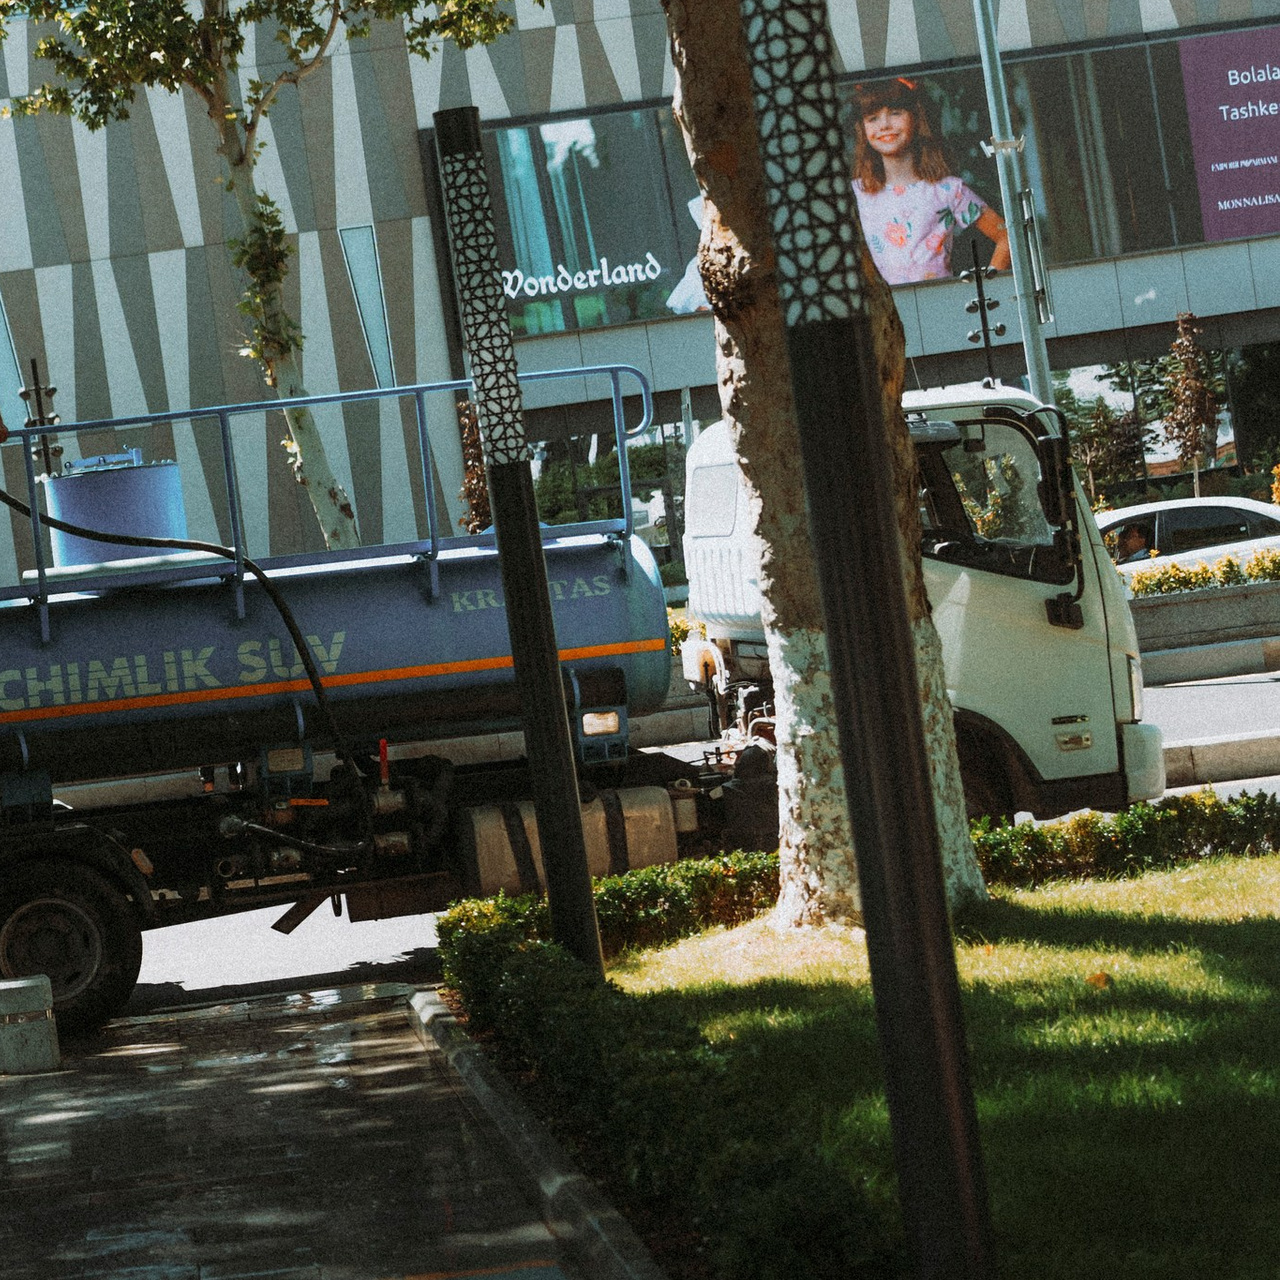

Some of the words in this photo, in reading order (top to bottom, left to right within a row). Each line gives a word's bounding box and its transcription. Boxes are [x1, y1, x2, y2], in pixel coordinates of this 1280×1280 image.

[1228, 63, 1280, 86] Bolala
[1219, 99, 1280, 121] Tashke
[1218, 193, 1280, 211] MONNALISA
[450, 575, 612, 613] KRTAS
[236, 631, 347, 683] SUV
